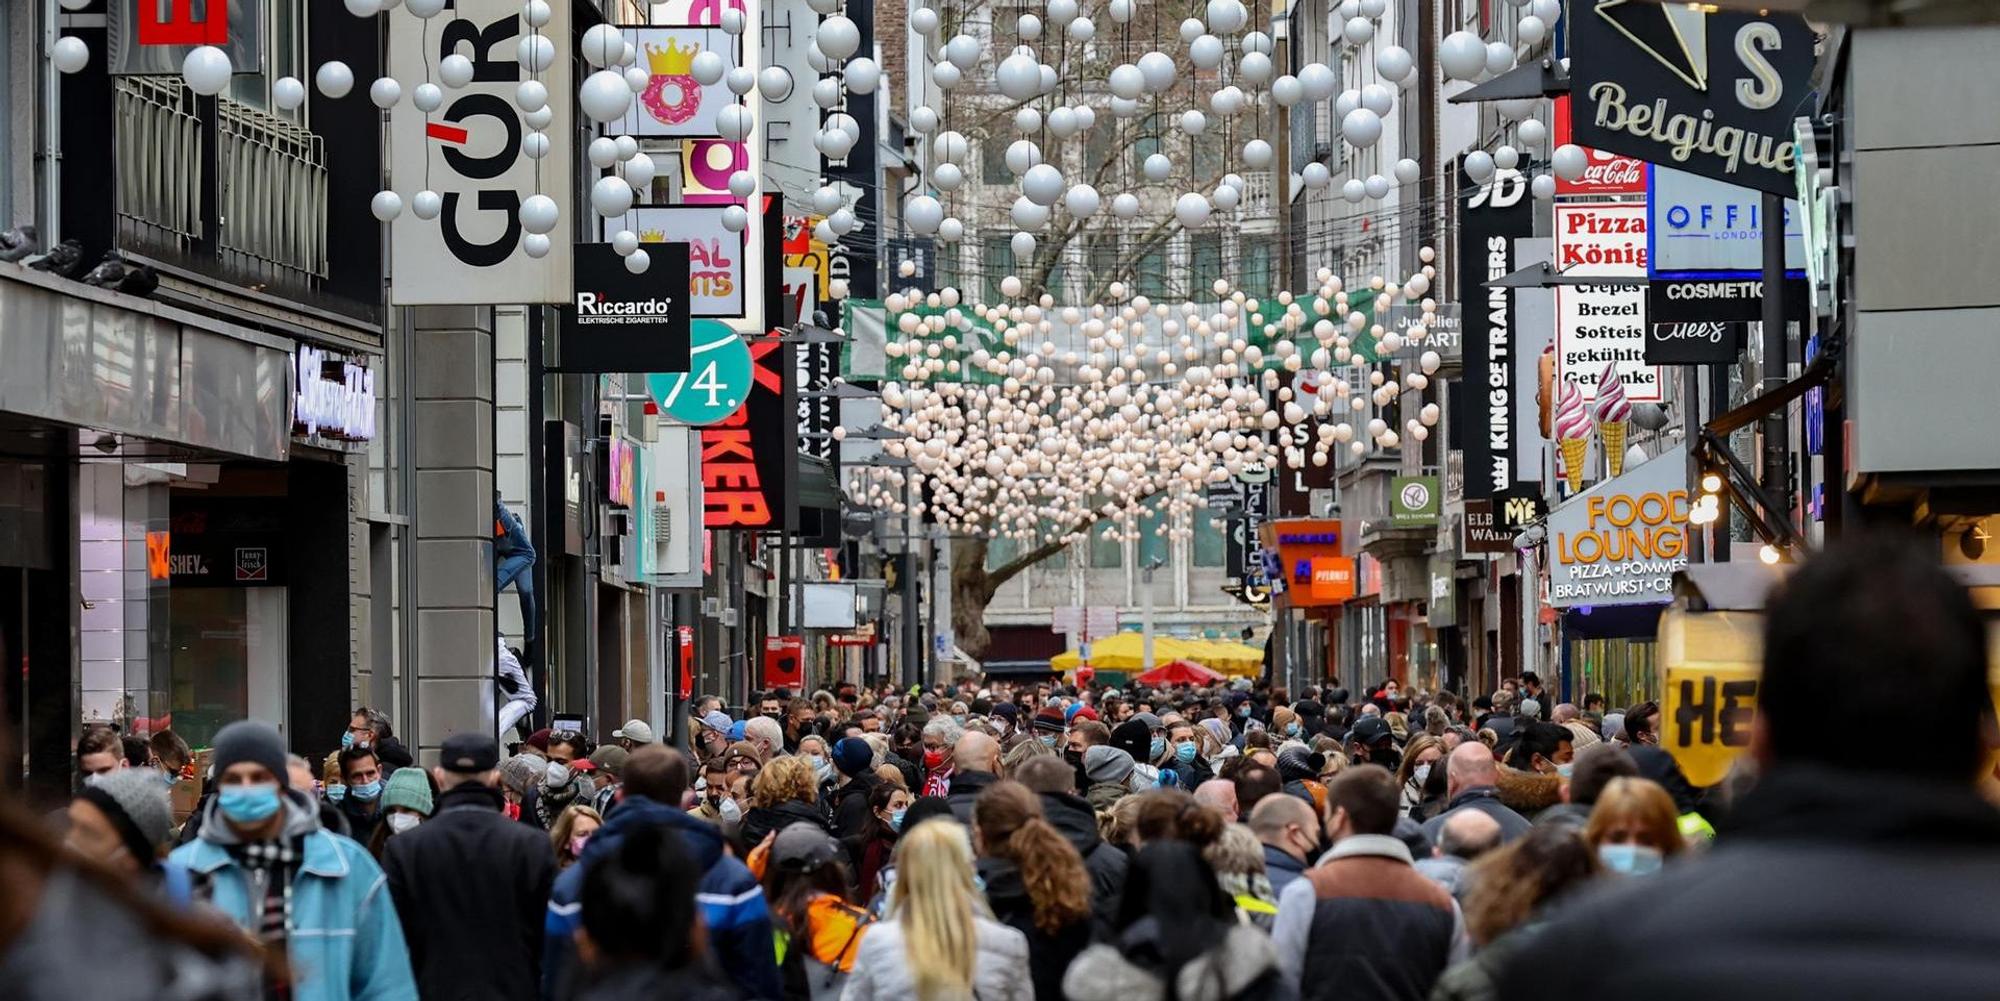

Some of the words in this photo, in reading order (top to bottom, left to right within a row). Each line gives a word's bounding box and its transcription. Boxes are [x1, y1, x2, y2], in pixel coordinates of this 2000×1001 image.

[1588, 82, 1796, 174] Belgique
[1567, 212, 1647, 235] Pizza
[1667, 204, 1790, 229] OFFI
[691, 236, 731, 267] AL
[1562, 242, 1648, 268] König
[1488, 235, 1508, 357] TRAINERS
[578, 317, 624, 325] ELEKTRISCHE
[1578, 302, 1639, 316] Brezel
[1424, 332, 1460, 347] ART
[1575, 325, 1642, 339] Softeis
[1489, 361, 1508, 389] OF
[1564, 370, 1655, 385] Getnke
[1489, 391, 1509, 450] KING
[1468, 513, 1493, 526] ELB
[1587, 490, 1688, 529] FOOD
[1556, 578, 1644, 598] BRATWURST
